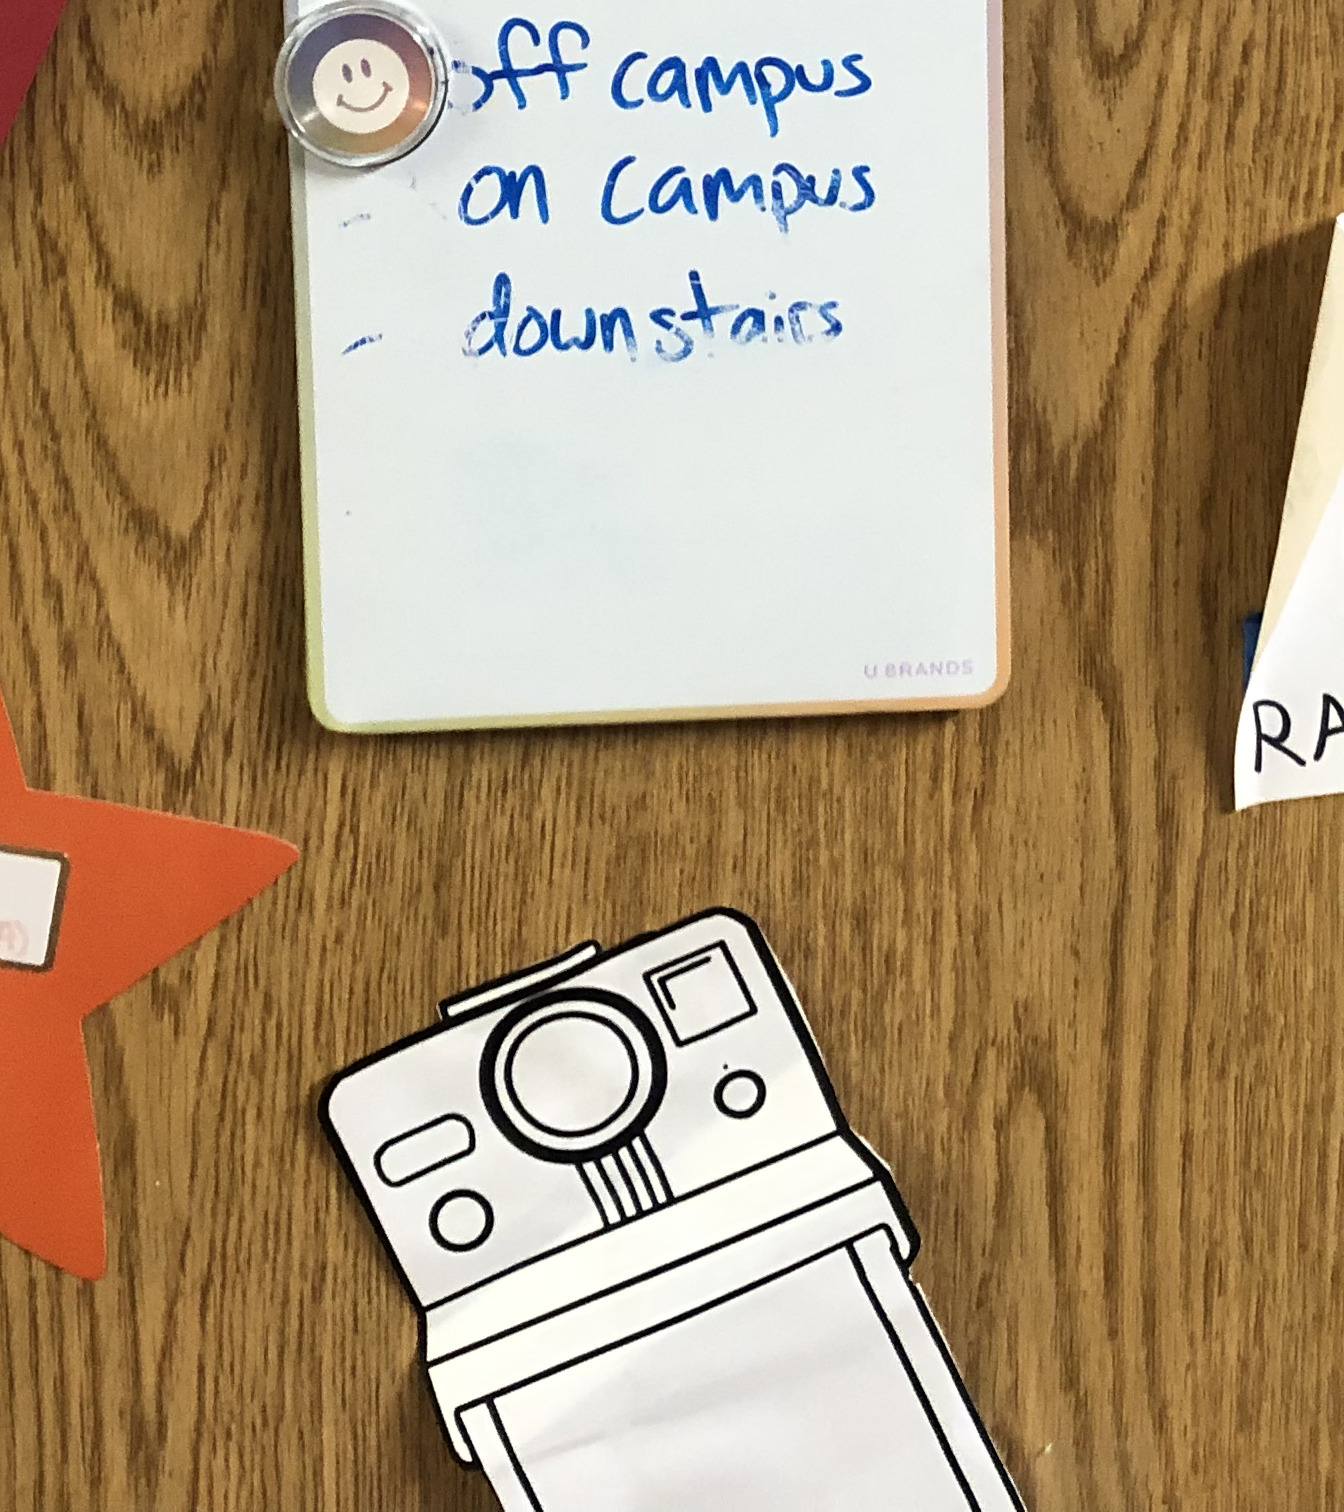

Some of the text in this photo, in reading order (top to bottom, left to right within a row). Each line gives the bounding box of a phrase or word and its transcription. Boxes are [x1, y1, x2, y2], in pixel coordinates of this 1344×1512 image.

[611, 51, 874, 137] campus
[458, 163, 549, 225] on
[884, 659, 974, 679] BRANDS
